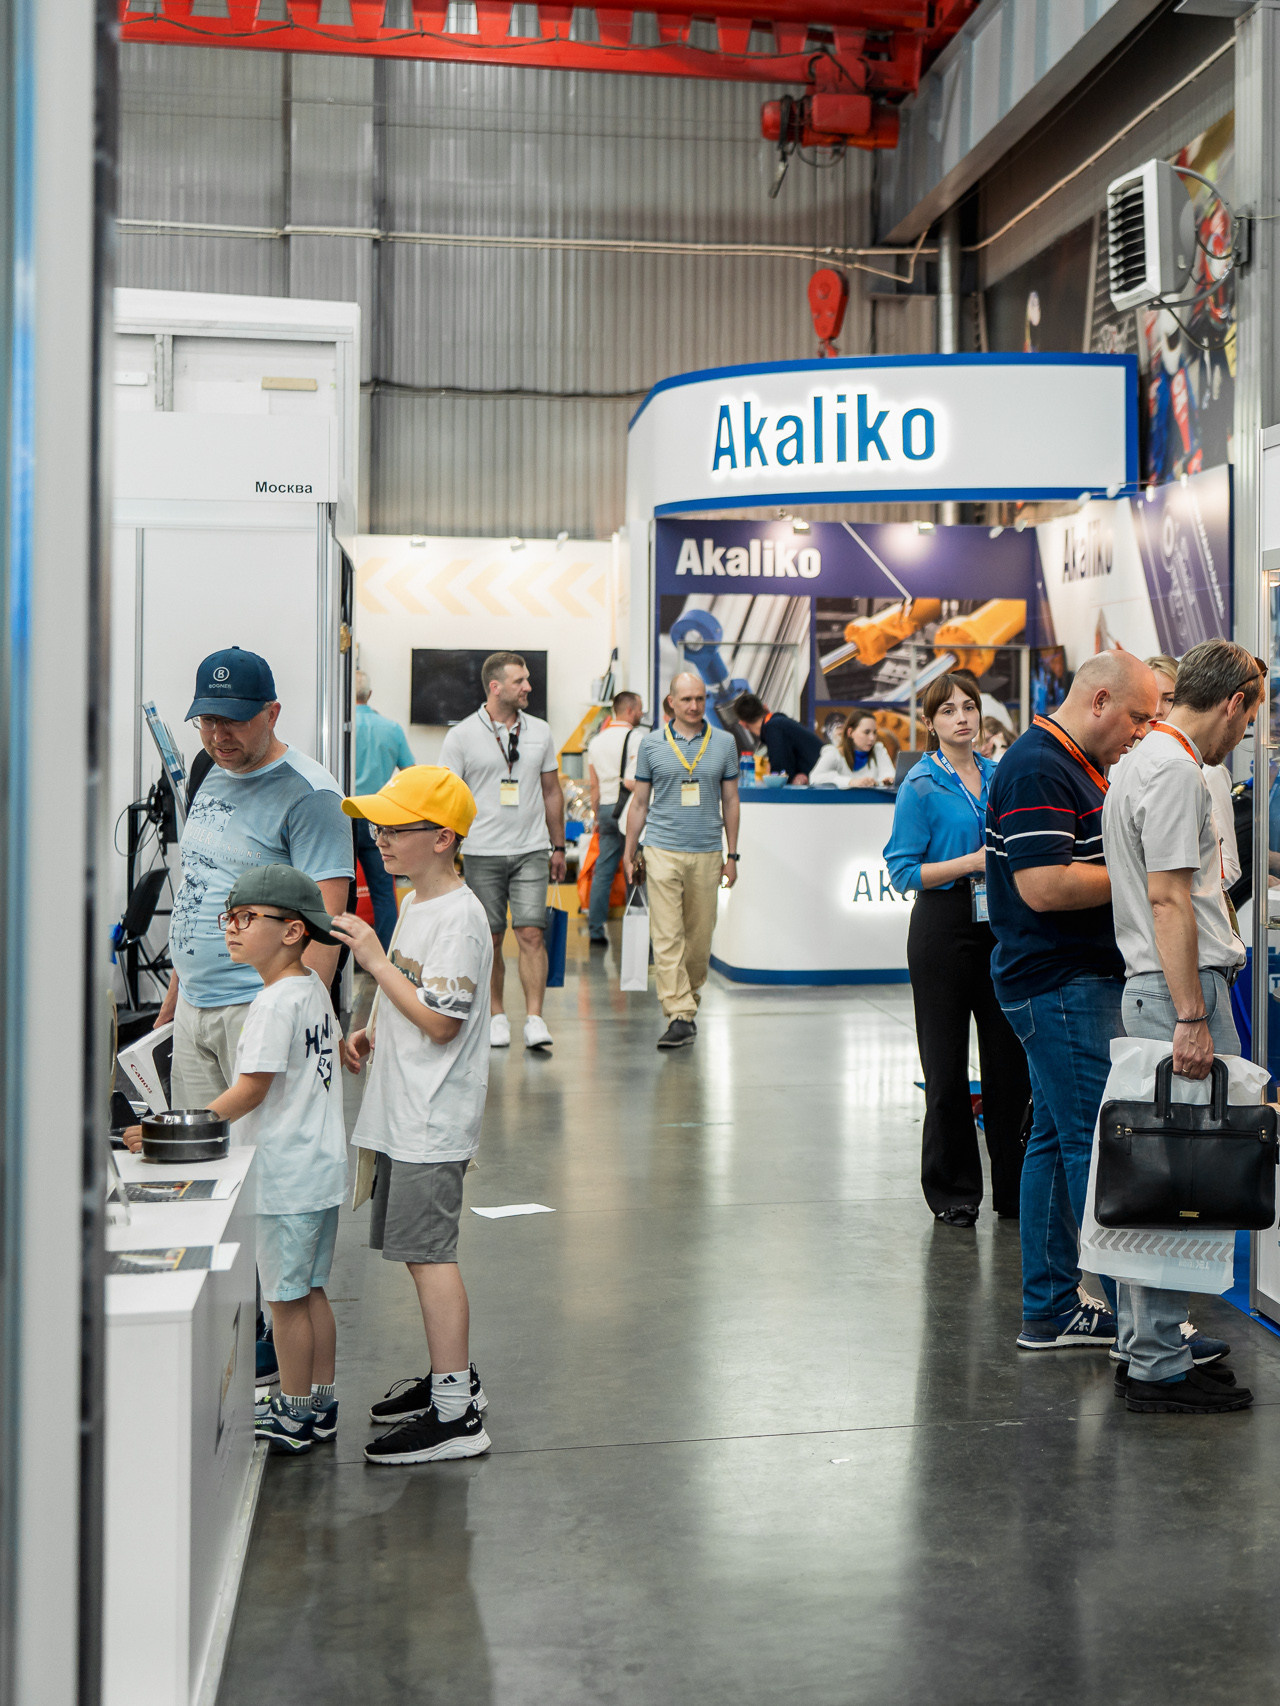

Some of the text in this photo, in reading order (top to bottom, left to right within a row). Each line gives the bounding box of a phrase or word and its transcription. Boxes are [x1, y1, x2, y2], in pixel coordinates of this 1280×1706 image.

[712, 394, 935, 471] Akaliko
[256, 482, 312, 493] Москва
[675, 537, 822, 579] Akaliko
[131, 1064, 152, 1093] Canon
[466, 1418, 479, 1429] FILA
